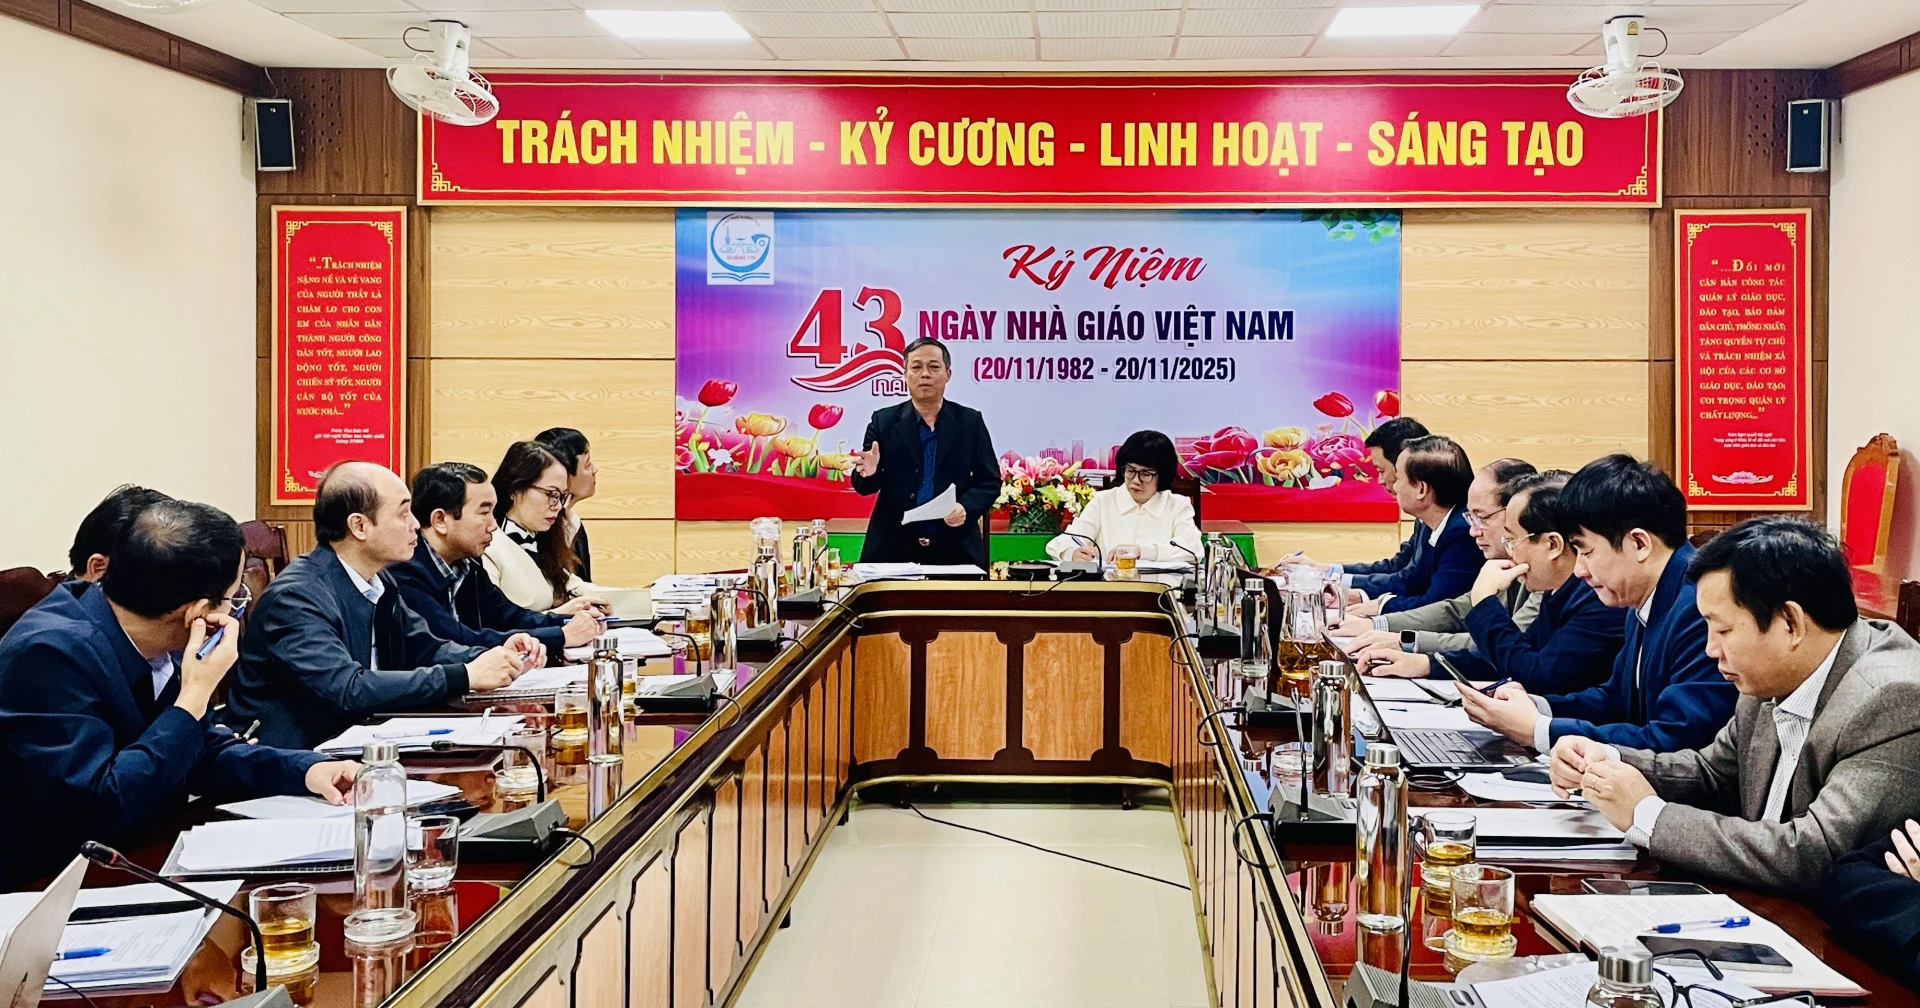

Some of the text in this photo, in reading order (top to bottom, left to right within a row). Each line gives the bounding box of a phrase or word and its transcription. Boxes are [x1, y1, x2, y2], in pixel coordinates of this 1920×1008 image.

[496, 105, 1584, 176] TRÁCH NHIỆM - KỶ CƯƠNG - LINH HOẠT - SÁNG TẠO
[355, 260, 382, 271] NHIỆM
[1003, 244, 1208, 291] Kỷ Niệm
[360, 276, 382, 284] VANG
[297, 289, 314, 299] CỦA
[317, 288, 343, 299] NGƯỜI
[326, 305, 337, 313] LO
[342, 305, 360, 314] CHO
[365, 305, 382, 314] CON
[297, 318, 381, 328] EM CỦA NHÂN DÂN
[787, 286, 906, 369] 43
[919, 304, 1295, 348] NGÀY NHÀ GIÁO VIỆT NAM
[329, 334, 355, 343] NGƯỜI
[337, 347, 363, 357] NGƯỜI
[366, 349, 382, 358] LAO
[1745, 351, 1772, 361] NHIỆM
[353, 362, 381, 372] NGƯỜI
[973, 356, 1094, 381] (20/11/1982
[1115, 356, 1236, 382] 20/11/2025)
[355, 378, 381, 387] NGƯỜI
[871, 374, 911, 396] nă
[322, 391, 333, 403] BỘ
[340, 391, 357, 401] TỐT
[364, 391, 381, 401] CỦA
[1700, 397, 1714, 405] COI
[1717, 397, 1746, 406] TRỌNG
